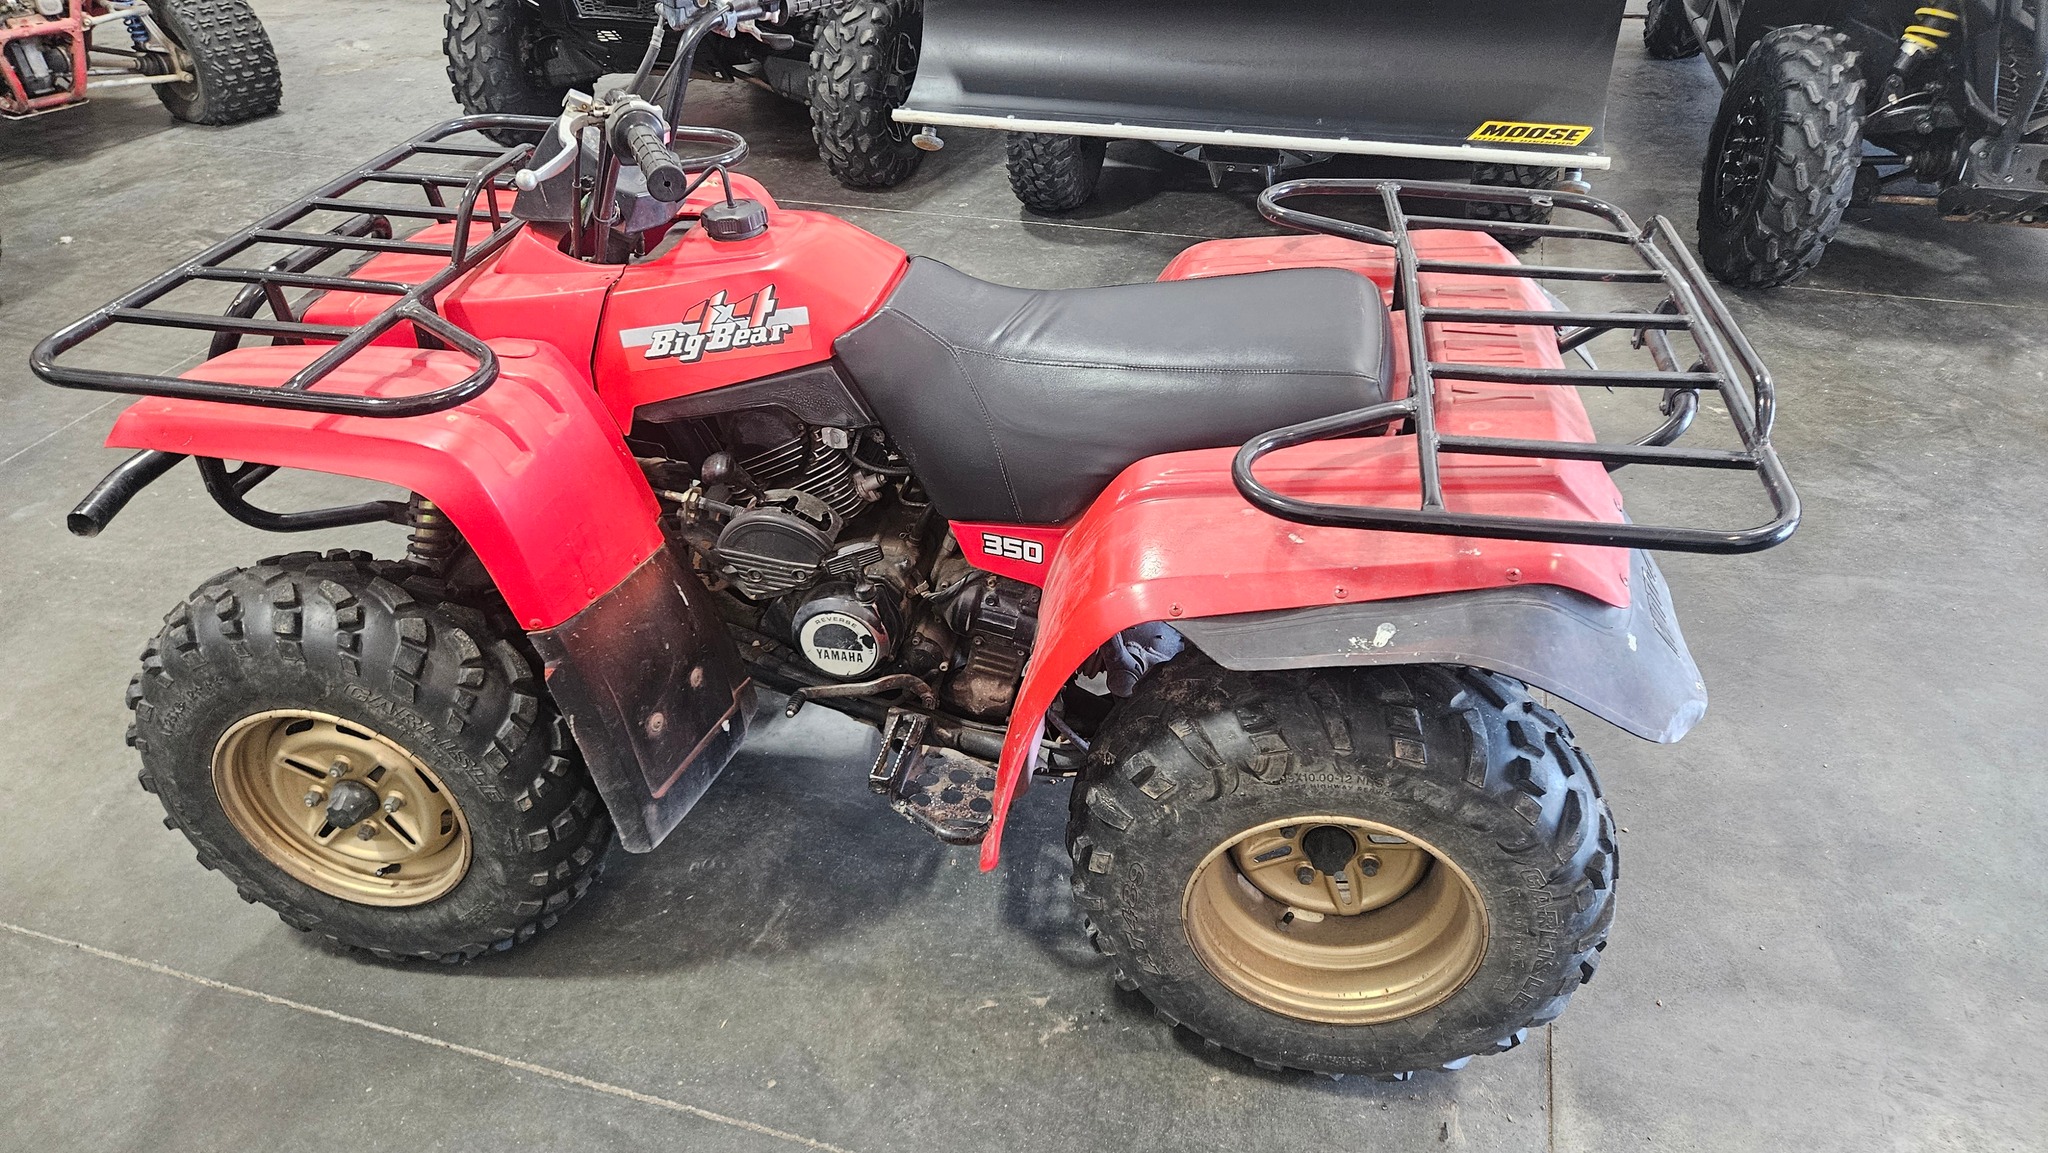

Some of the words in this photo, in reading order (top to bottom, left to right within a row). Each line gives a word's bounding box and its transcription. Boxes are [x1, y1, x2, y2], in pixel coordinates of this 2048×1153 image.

[1480, 124, 1586, 141] MOOSE
[982, 532, 1044, 565] 350
[814, 616, 858, 629] REVERSE
[816, 648, 864, 664] YAMAHA
[343, 682, 505, 802] CARLISLE
[1510, 867, 1558, 1011] CARLISLE
